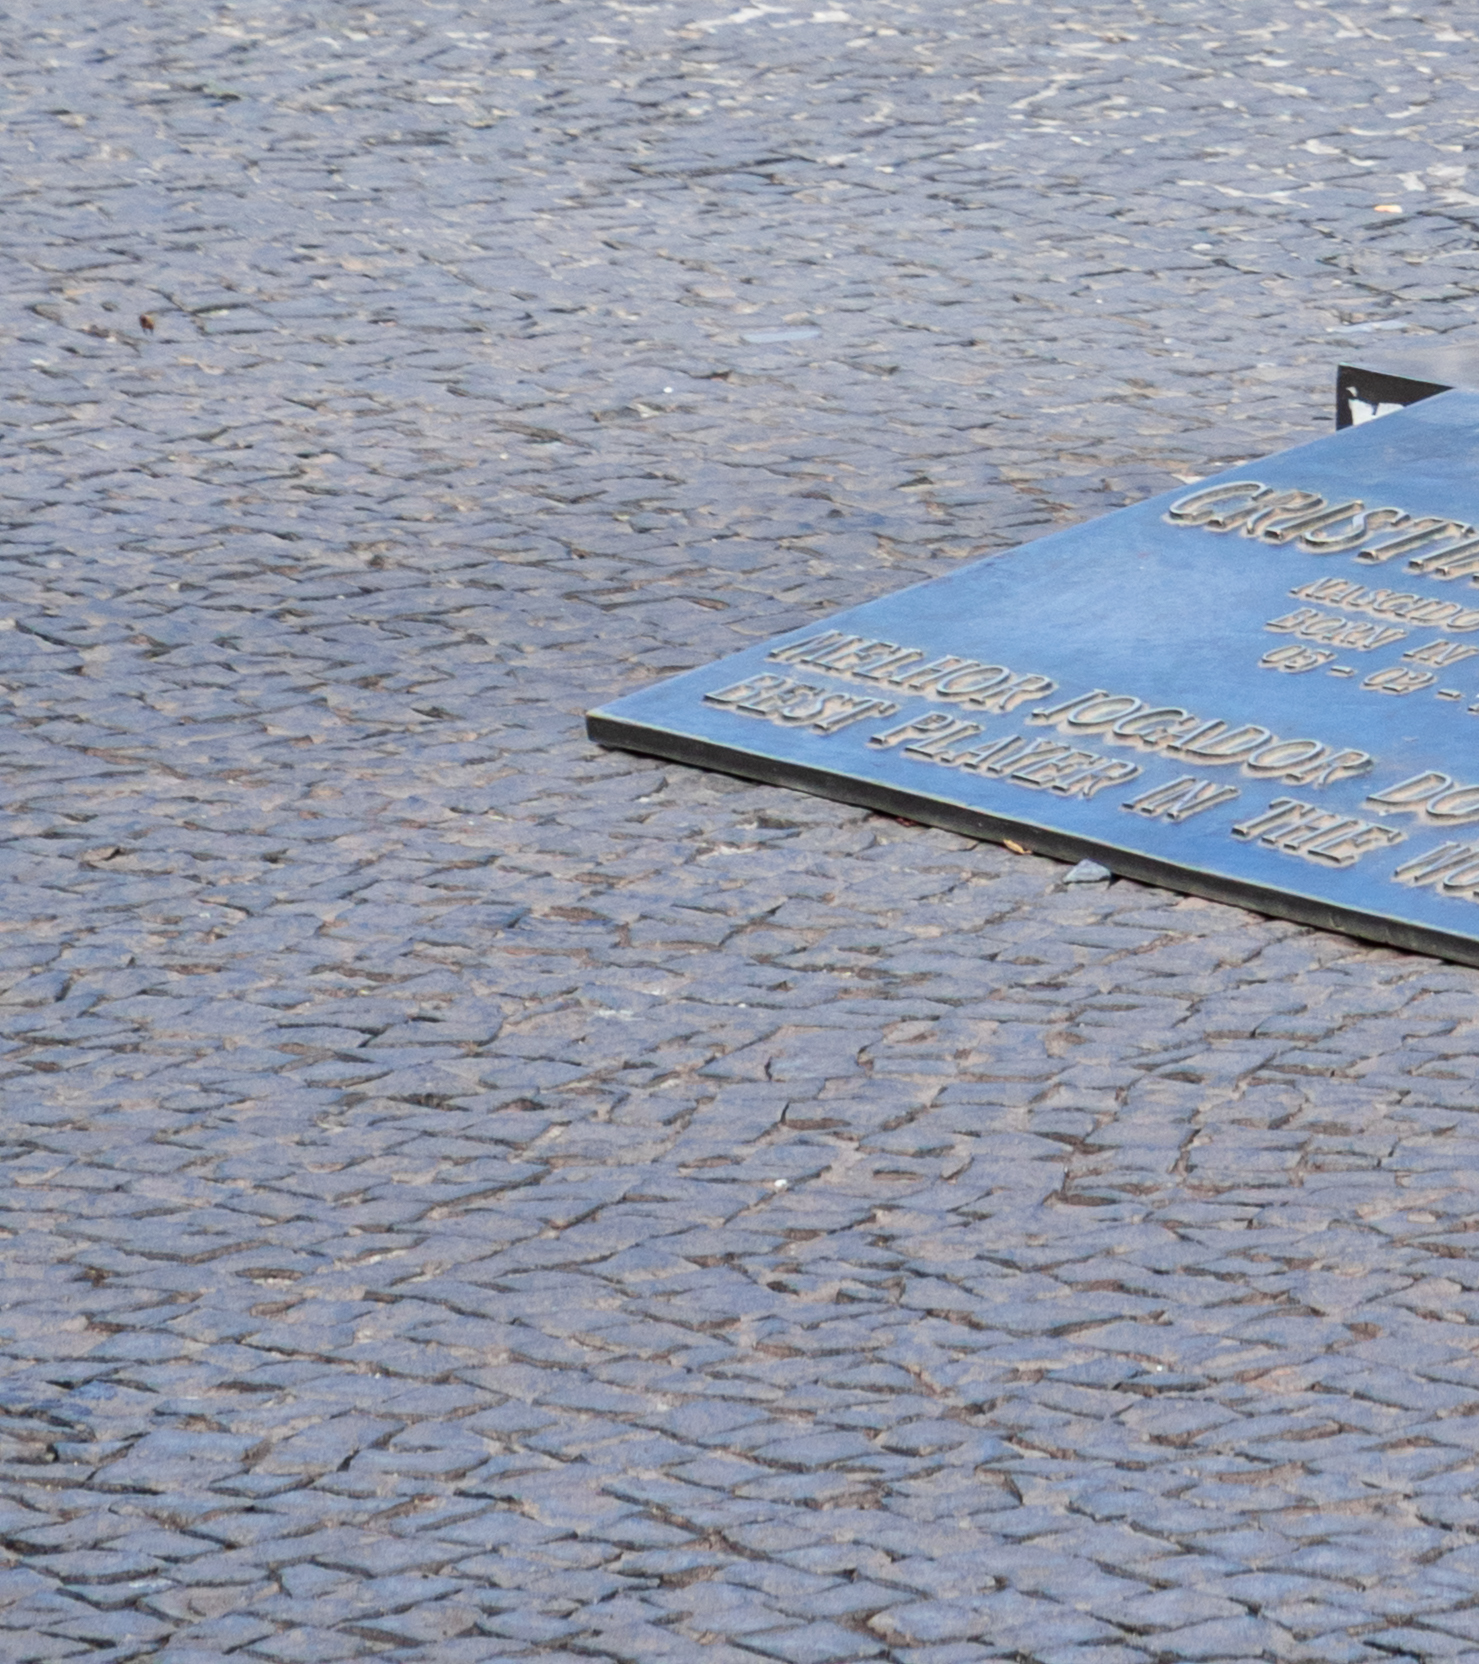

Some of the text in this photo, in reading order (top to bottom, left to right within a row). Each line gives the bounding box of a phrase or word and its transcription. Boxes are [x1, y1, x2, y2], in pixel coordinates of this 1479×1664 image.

[1261, 644, 1335, 671] 05
[1362, 667, 1436, 692] 02
[1265, 607, 1407, 649] BORN
[1403, 639, 1479, 666] IN
[767, 629, 1056, 711] MELHOR
[1032, 689, 1373, 786] JOGADOR
[704, 673, 896, 732] BEST
[869, 710, 1140, 797] PLAYER
[1121, 774, 1239, 820] IN
[1231, 796, 1403, 866] THE
